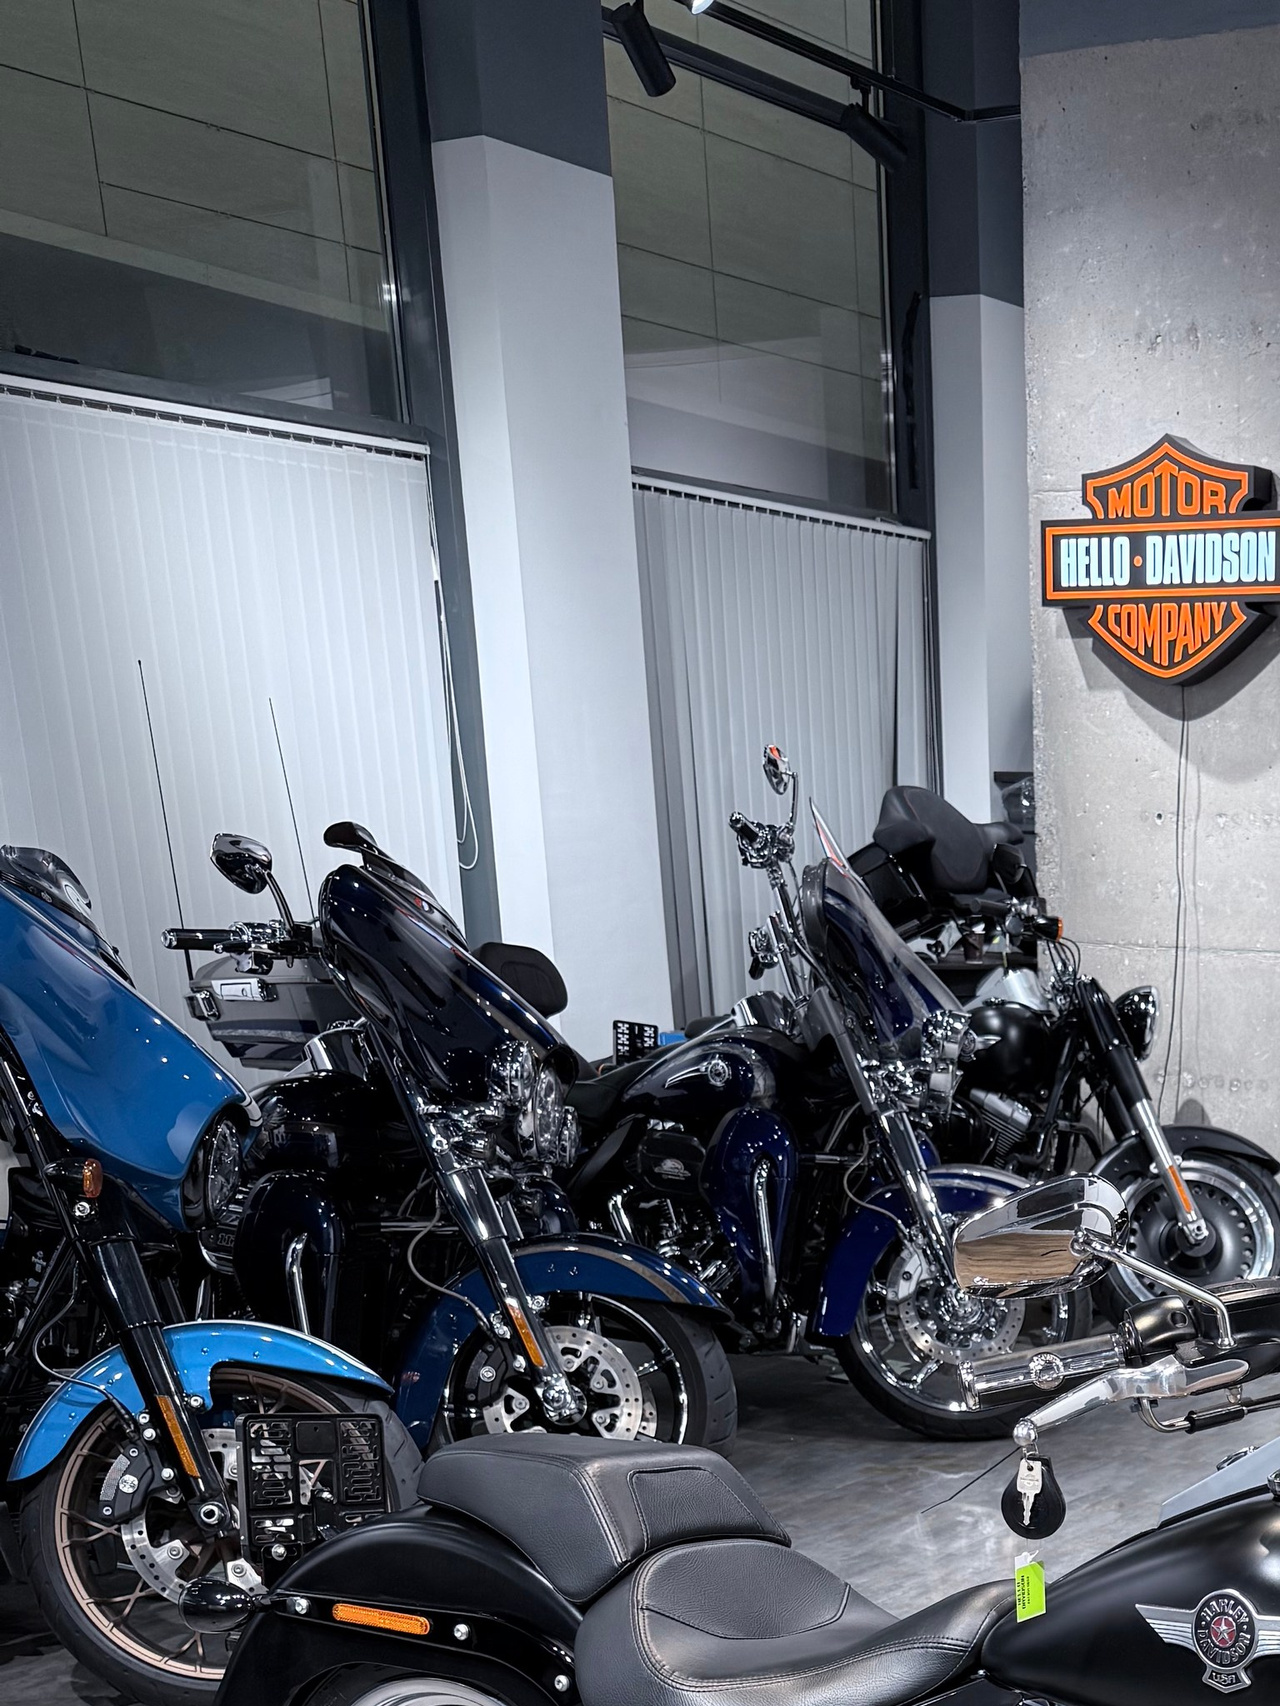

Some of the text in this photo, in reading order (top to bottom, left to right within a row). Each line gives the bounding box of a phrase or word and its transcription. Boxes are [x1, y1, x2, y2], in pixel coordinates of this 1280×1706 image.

[1108, 459, 1227, 518] MOTOR
[1060, 531, 1276, 587] HELLO DAVIDSON
[1107, 601, 1227, 666] COMPANY
[1201, 1599, 1249, 1624] HARLEY
[1197, 1629, 1251, 1665] DAVIDSON
[1212, 1672, 1236, 1685] USA
